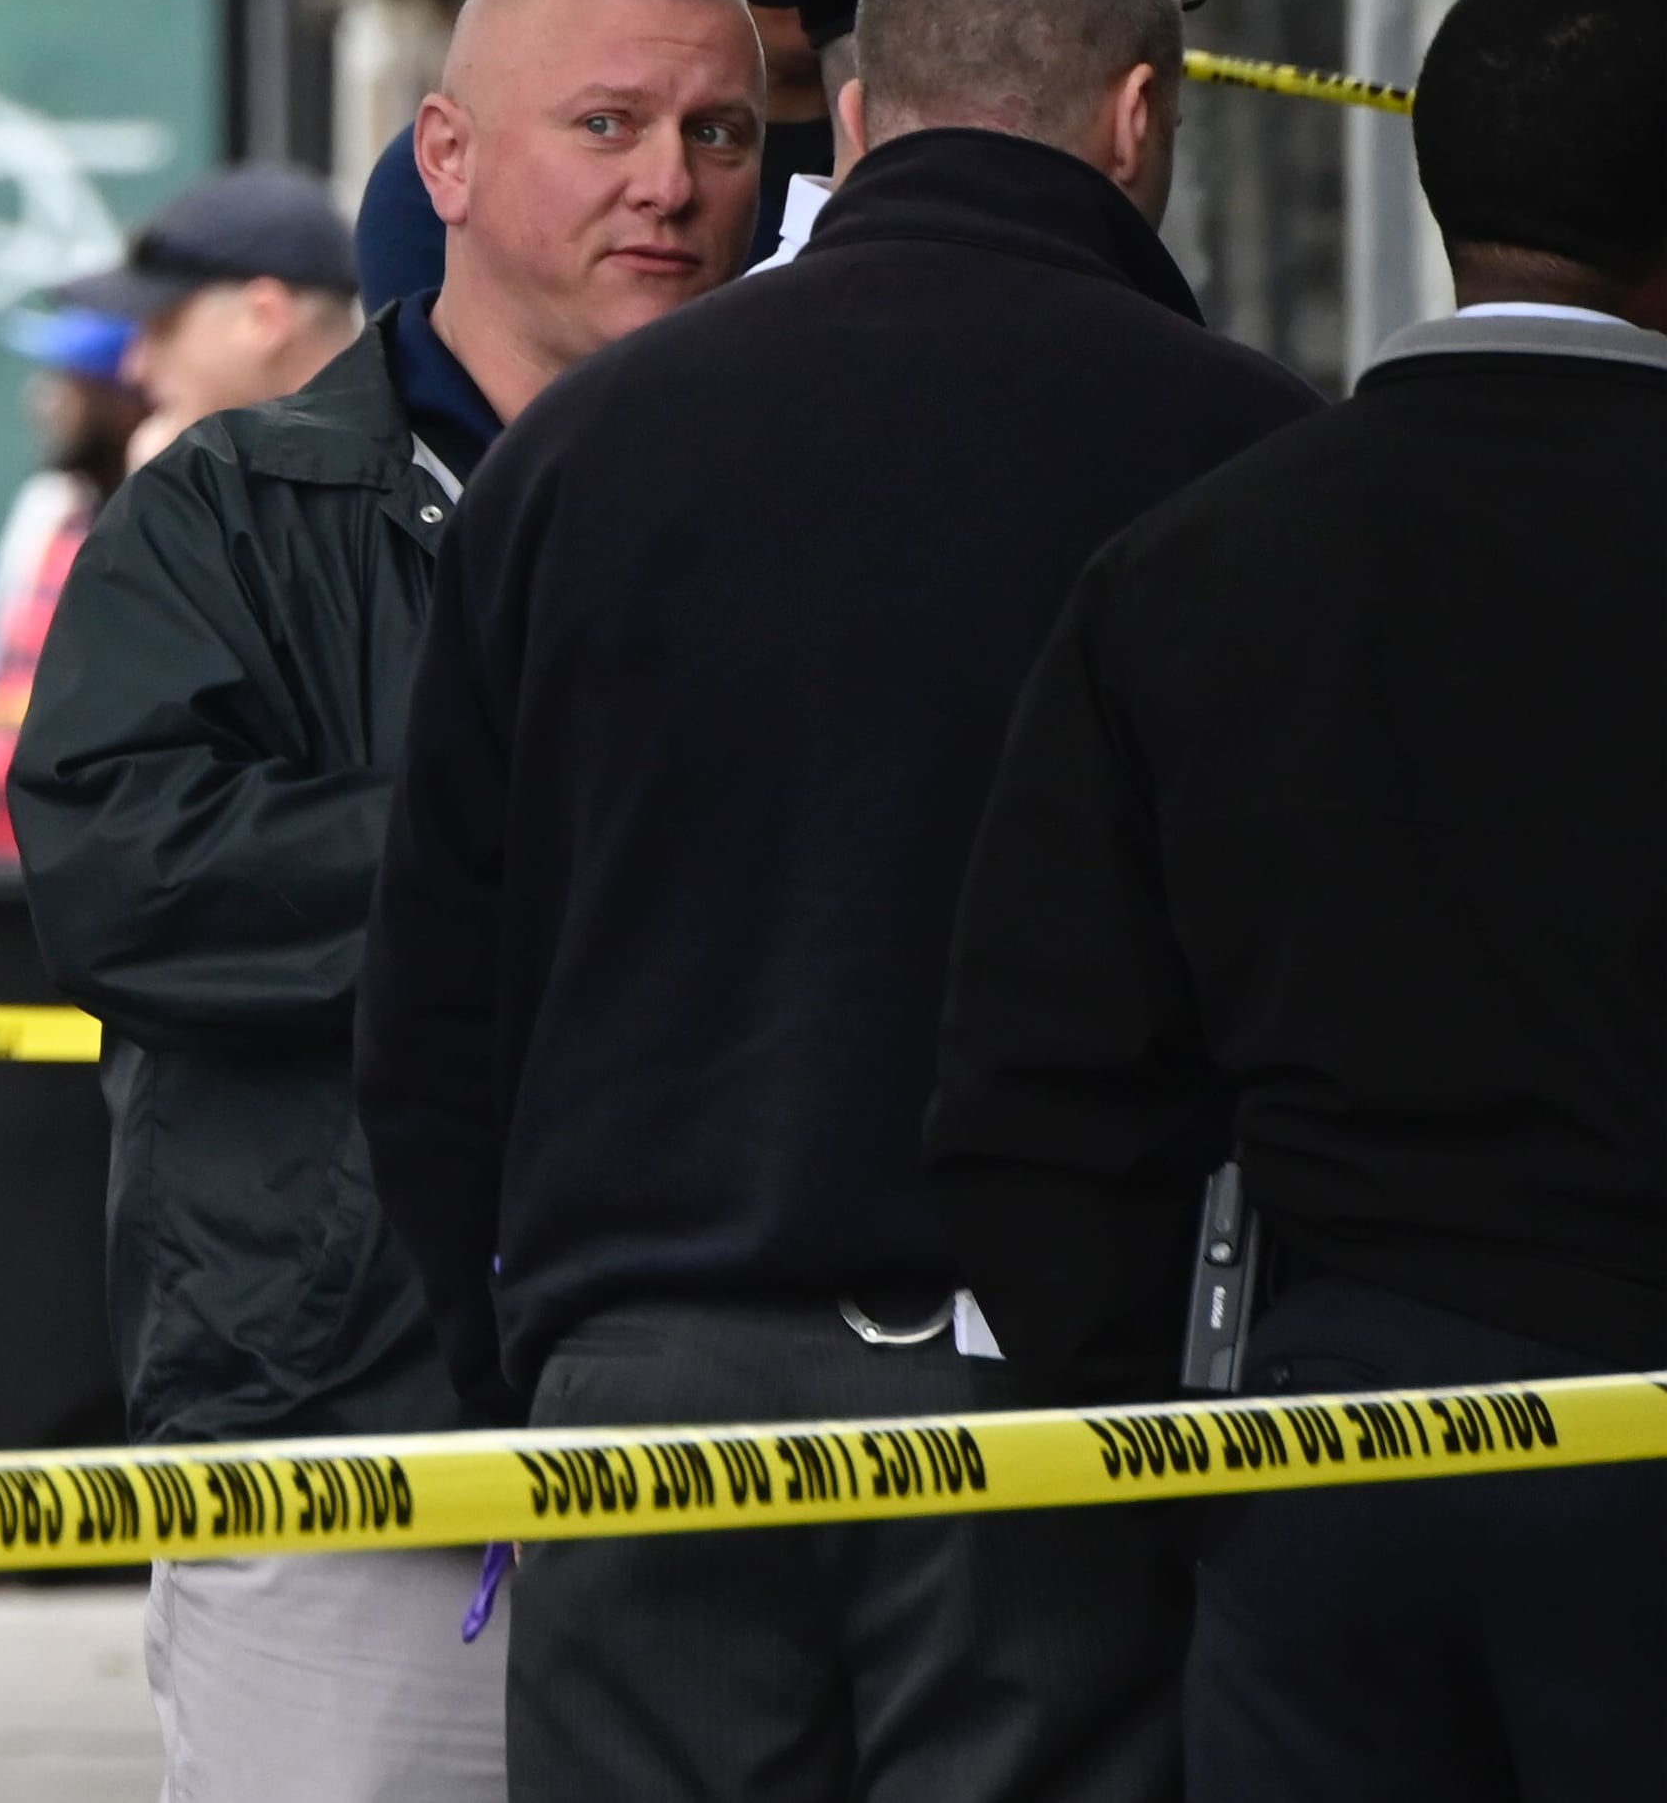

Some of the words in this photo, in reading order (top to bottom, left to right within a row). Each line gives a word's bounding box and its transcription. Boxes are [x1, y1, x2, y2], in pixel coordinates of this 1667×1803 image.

[1082, 1417, 1212, 1479] CROSS
[1217, 1410, 1289, 1470] NOT
[1289, 1405, 1345, 1463] DO
[1345, 1402, 1432, 1459] LINE
[1432, 1393, 1560, 1449] POLICE
[290, 1457, 414, 1532] POLICE
[513, 1447, 639, 1517] CROSS
[641, 1443, 717, 1509] NOT
[714, 1439, 774, 1506] DO
[775, 1433, 859, 1502] LINE
[865, 1426, 987, 1498] POLICE
[67, 1465, 140, 1545] NOT
[140, 1461, 198, 1539] DO
[207, 1460, 286, 1536] LINE
